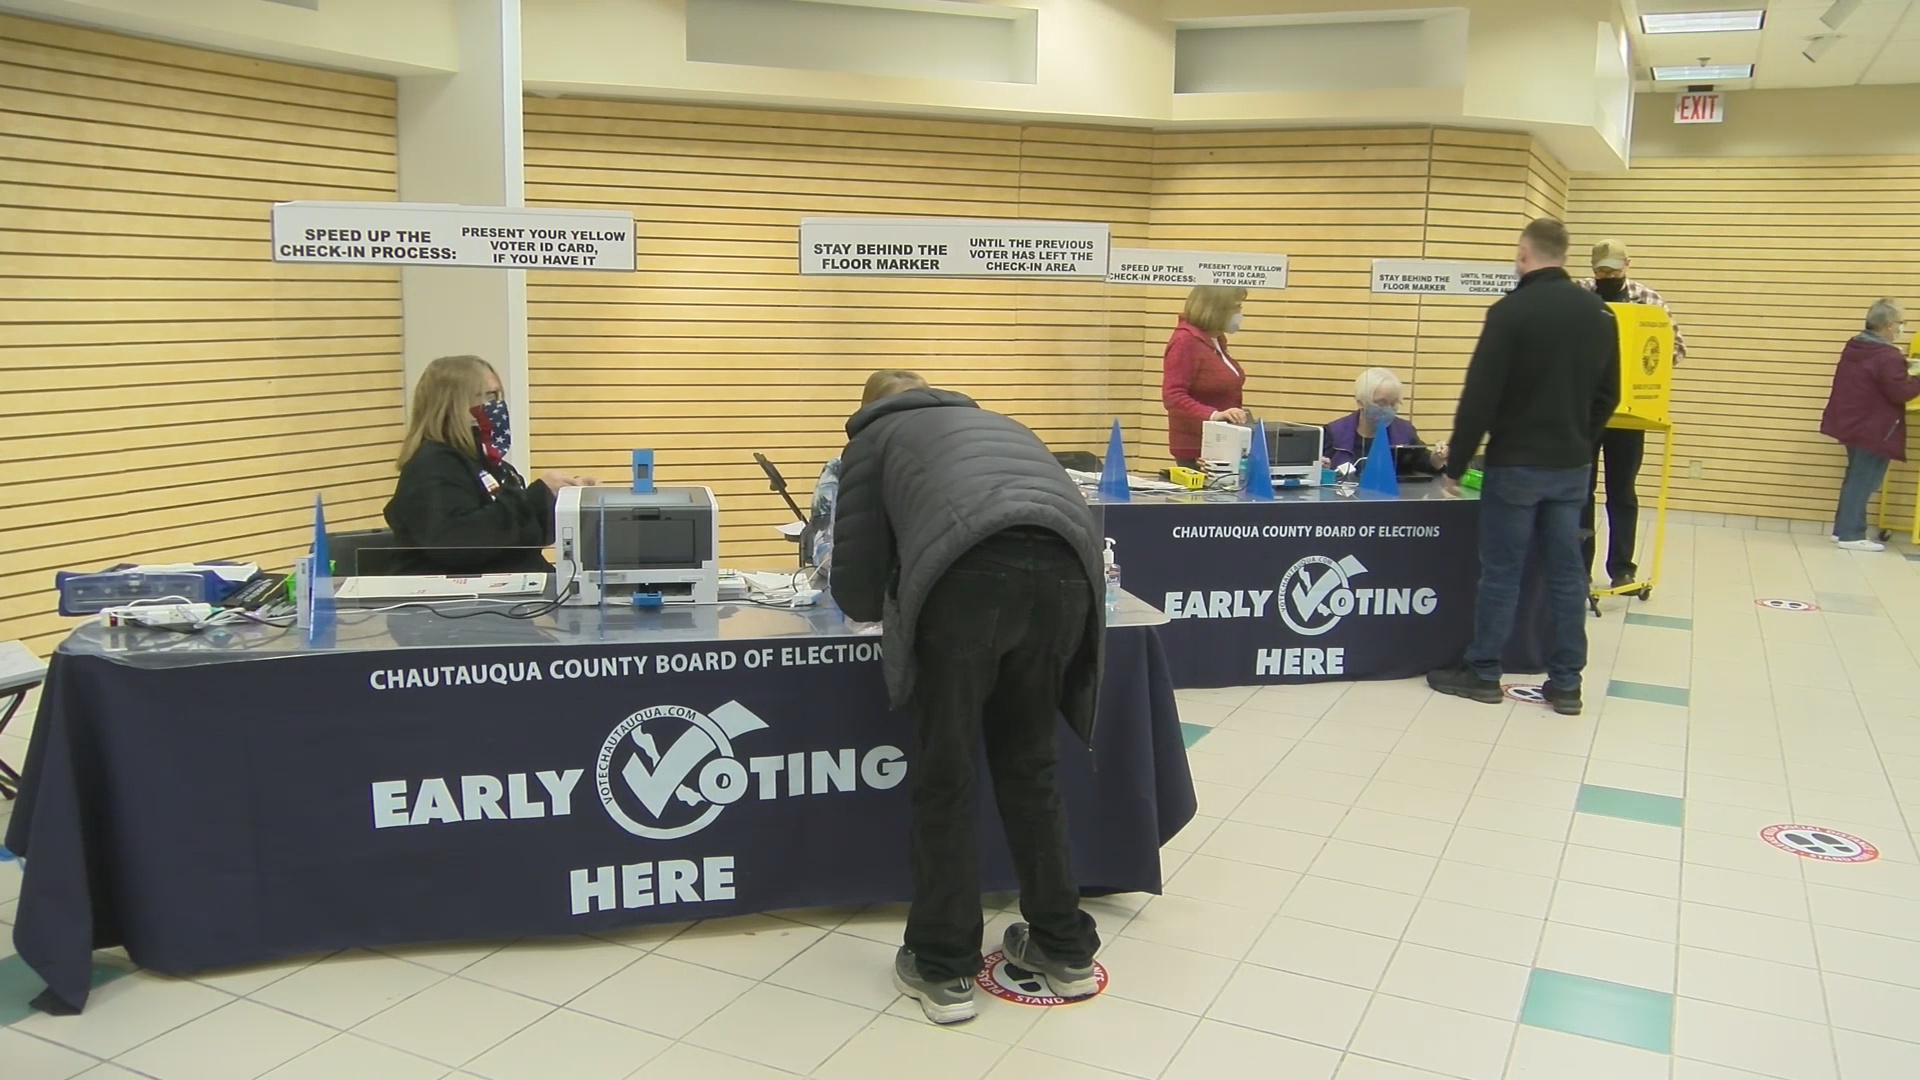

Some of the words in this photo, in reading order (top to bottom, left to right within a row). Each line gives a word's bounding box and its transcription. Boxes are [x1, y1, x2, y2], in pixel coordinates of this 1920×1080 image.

[1680, 95, 1719, 120] EXIT
[305, 229, 361, 241] SPEED
[368, 230, 390, 242] UP
[396, 231, 431, 243] THE
[462, 227, 525, 238] PRESENT
[529, 229, 566, 239] YOUR
[571, 231, 625, 241] YELLOW
[490, 241, 535, 251] VOTER
[540, 242, 553, 251] ID
[558, 243, 598, 255] CARD,
[814, 244, 851, 254] STAY
[857, 244, 913, 255] BEHIND
[918, 245, 947, 255] THE
[970, 238, 1005, 247] UNTIL
[1009, 239, 1031, 248] THE
[1036, 240, 1093, 249] PREVIOUS
[280, 245, 365, 257] CHECK-IN
[372, 247, 456, 259] PROCESS:
[970, 250, 1008, 259] VOTER
[1012, 251, 1035, 259] HAS
[1039, 251, 1067, 260] LEFT
[1070, 252, 1093, 260] THE
[494, 254, 505, 263] IF
[510, 254, 538, 264] YOU
[543, 255, 578, 265] HAVE
[583, 256, 596, 265] IT
[823, 259, 872, 269] FLOOR
[877, 259, 939, 270] MARKER
[986, 262, 1042, 271] CHECK-IN
[1045, 263, 1076, 271] AREA
[1121, 264, 1149, 272] SPEED
[1167, 265, 1184, 273] THE
[1109, 273, 1150, 281] CHECK-IN
[1153, 274, 1196, 283] PROCESS:
[1173, 526, 1259, 538] CHAUTAUQUA
[1263, 526, 1312, 537] COUNTY
[1316, 526, 1355, 537] BOARD
[1359, 526, 1375, 537] OF
[1379, 526, 1439, 537] ELECTIONS
[1164, 590, 1273, 618] EARLY
[369, 661, 542, 690] CHAUTAUQUA
[549, 655, 648, 680] COUNTY
[656, 651, 737, 675] BOARD
[743, 648, 774, 669] OF
[780, 642, 886, 667] ELECTION
[1256, 648, 1344, 675] HERE
[598, 707, 697, 805] VOTECHAUTAUQUA.COM
[371, 768, 585, 829] EARLY
[570, 855, 736, 916] HERE
[1015, 995, 1065, 1004] STAND
